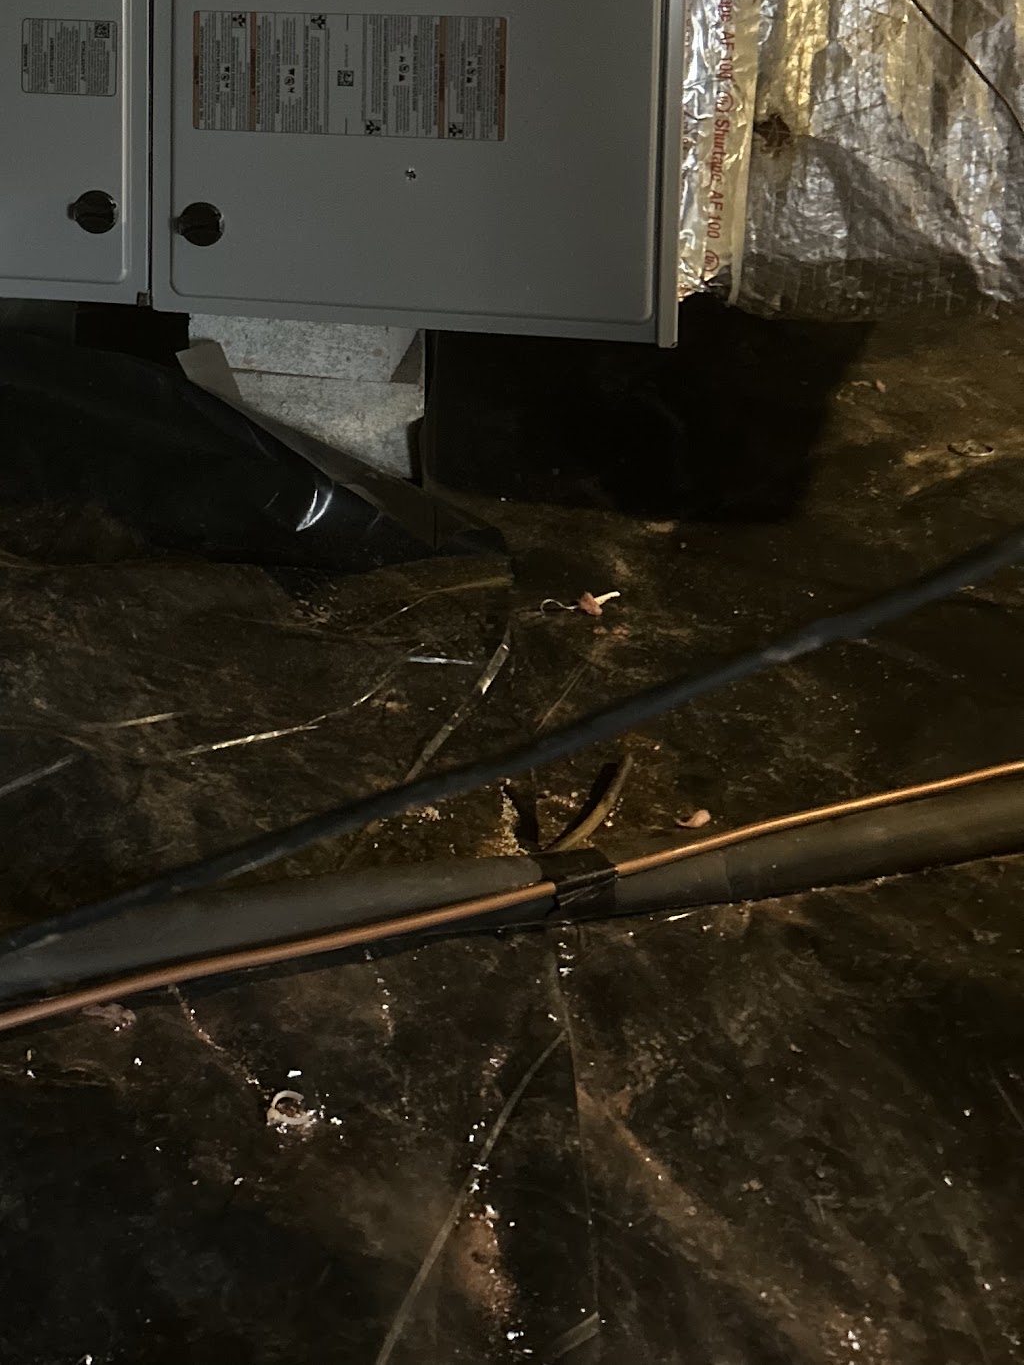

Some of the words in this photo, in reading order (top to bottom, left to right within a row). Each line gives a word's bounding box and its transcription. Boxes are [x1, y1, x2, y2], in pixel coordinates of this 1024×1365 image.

[722, 32, 735, 50] AF
[710, 118, 730, 184] Shurtape
[711, 190, 725, 212] AF
[707, 215, 721, 239] 100
